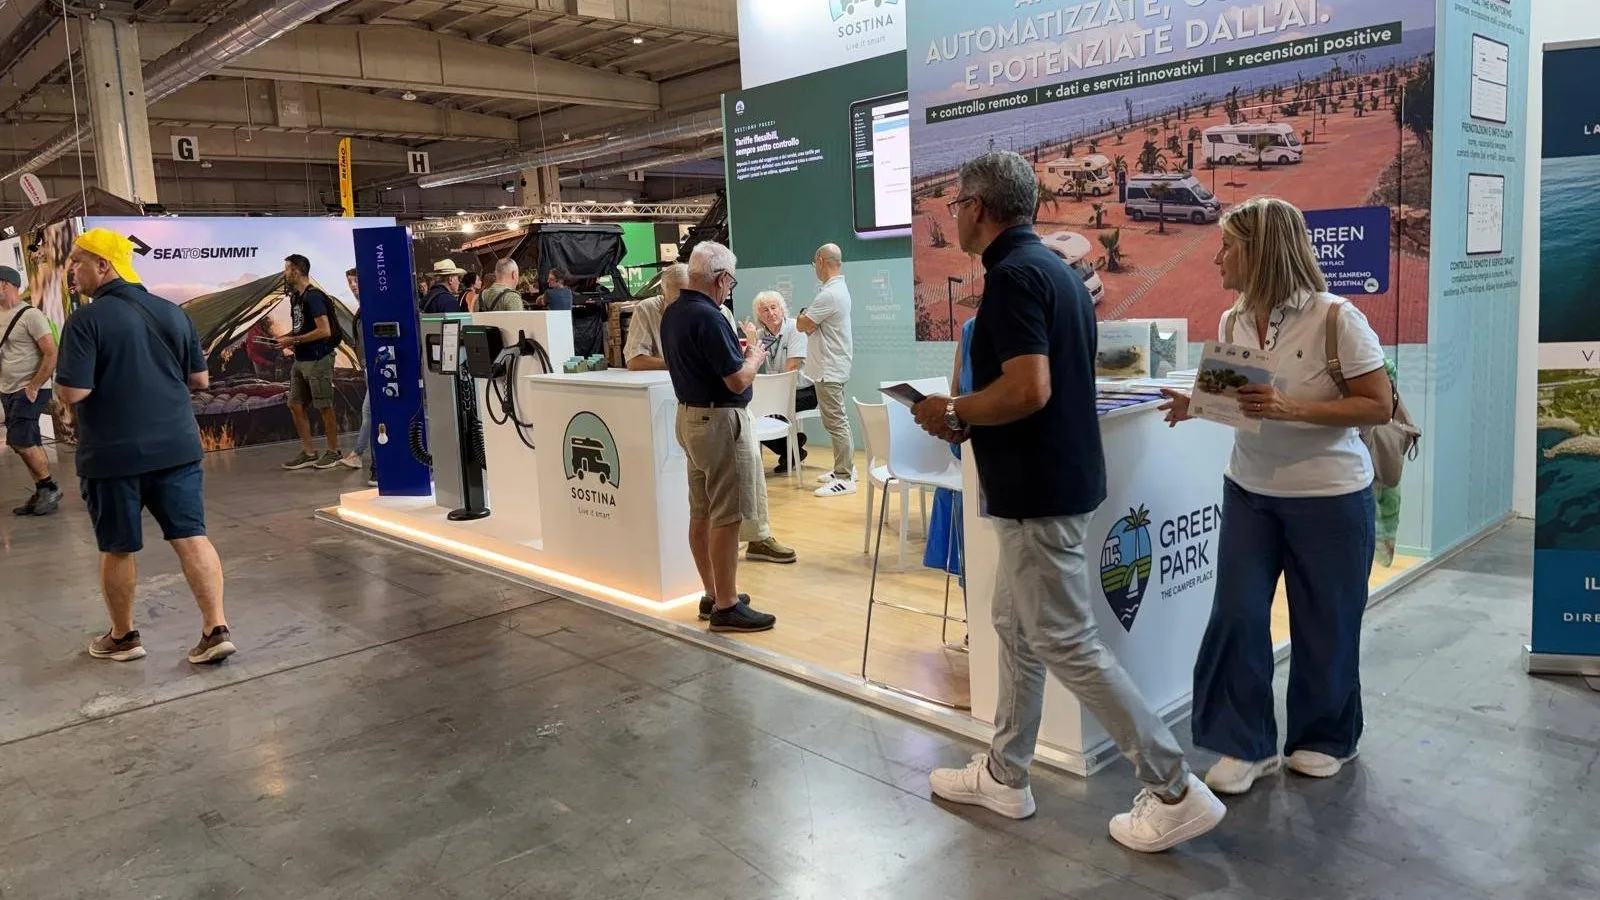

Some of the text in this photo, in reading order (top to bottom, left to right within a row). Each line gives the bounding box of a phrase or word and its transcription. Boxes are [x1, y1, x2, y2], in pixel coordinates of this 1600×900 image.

[838, 14, 893, 38] SOSTINA
[965, 0, 1331, 91] E POTENZIATE DALL'AI.
[939, 101, 986, 119] controllo
[988, 94, 1029, 110] remoto
[1056, 80, 1079, 98] dati
[1083, 83, 1090, 93] e
[1093, 70, 1134, 91] servizi
[1137, 58, 1204, 83] innovativi
[1239, 38, 1319, 66] recensioni
[1324, 29, 1392, 54] positive
[177, 138, 194, 160] G
[735, 137, 800, 157] sempre sotto controllo
[412, 153, 426, 173] H
[1311, 243, 1345, 259] ARK
[375, 243, 388, 292] SOSTINA
[571, 487, 616, 507] SOSTINA
[1160, 503, 1222, 549] GREEN
[1160, 539, 1210, 585] PARK
[1161, 569, 1214, 600] THE CAMPER PLACE
